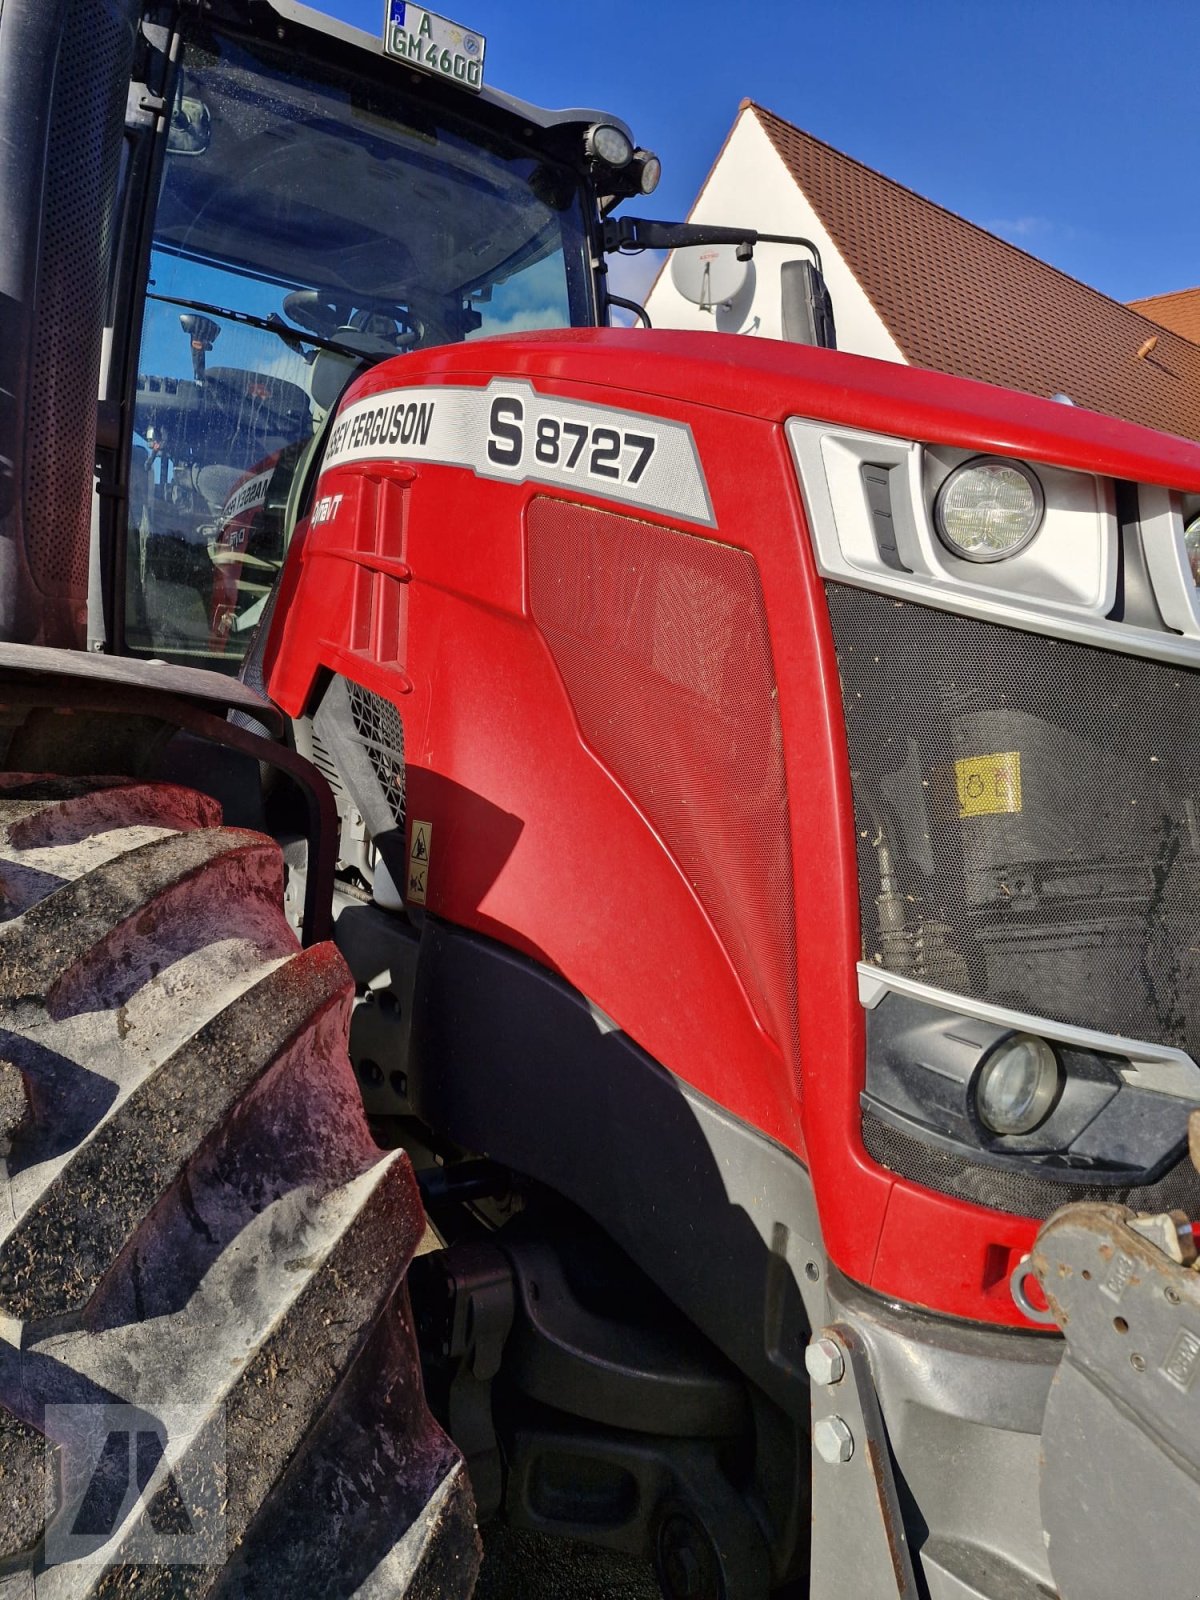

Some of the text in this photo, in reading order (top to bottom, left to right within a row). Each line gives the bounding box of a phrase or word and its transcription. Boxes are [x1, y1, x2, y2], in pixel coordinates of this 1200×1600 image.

[418, 12, 432, 39] A
[347, 402, 435, 450] FERGUSON
[487, 396, 656, 484] S 8727
